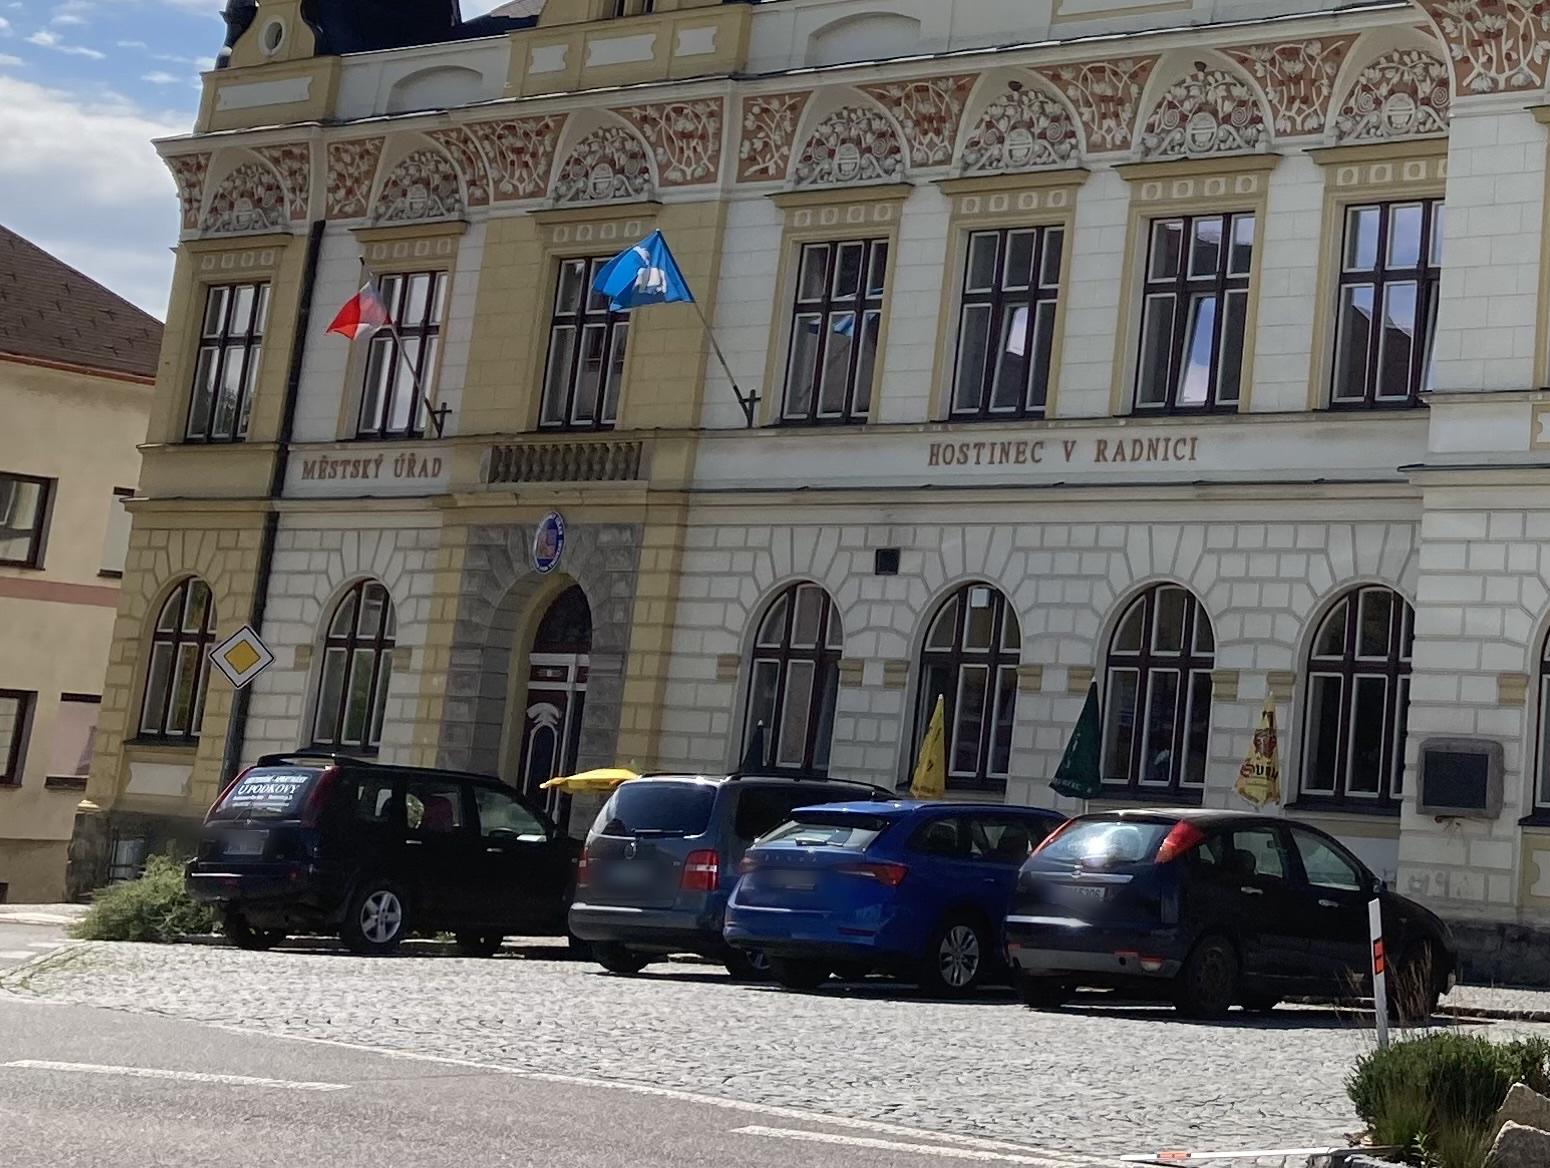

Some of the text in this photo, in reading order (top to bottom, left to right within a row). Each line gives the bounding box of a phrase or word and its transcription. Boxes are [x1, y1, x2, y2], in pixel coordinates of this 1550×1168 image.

[928, 437, 1198, 466] HOSTINEC V RADNICI
[301, 452, 442, 480] MĚSTSKÝ ÚŘAD
